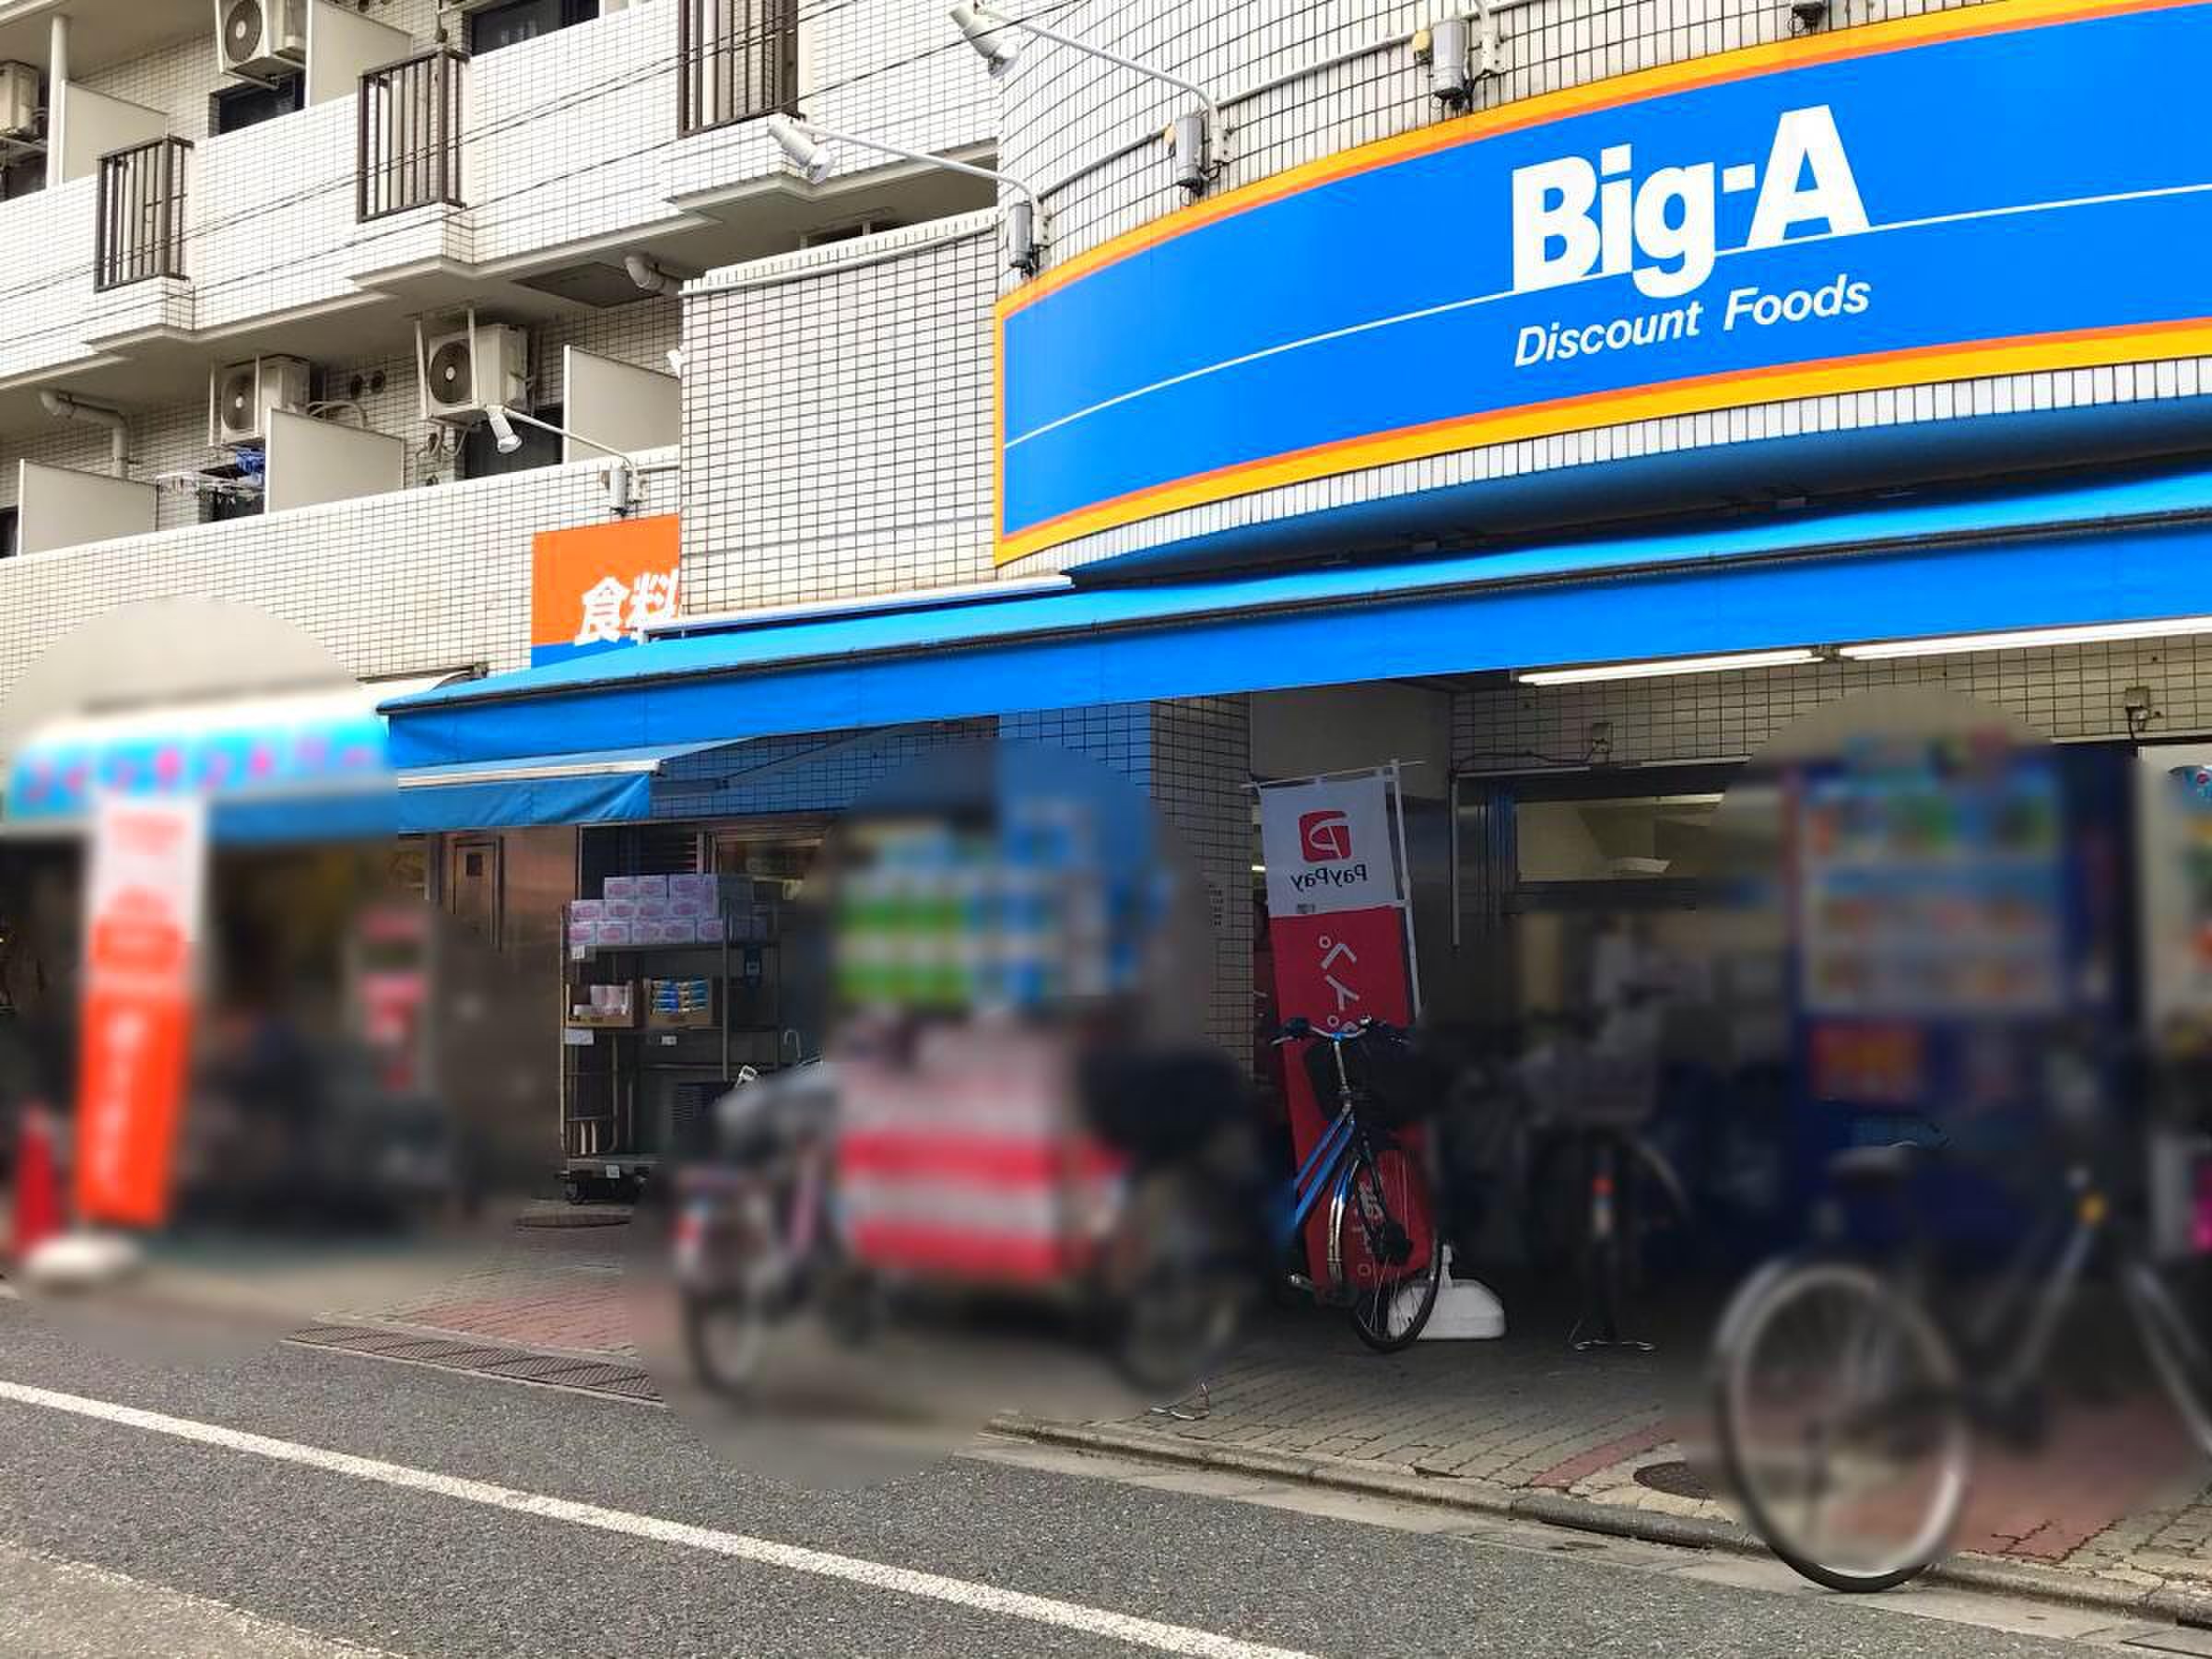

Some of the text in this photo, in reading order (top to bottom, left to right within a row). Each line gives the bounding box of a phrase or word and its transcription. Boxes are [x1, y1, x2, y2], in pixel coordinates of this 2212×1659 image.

[1512, 104, 1871, 299] Big-A
[1514, 274, 1872, 368] Discount Foods
[574, 567, 679, 646] 食料
